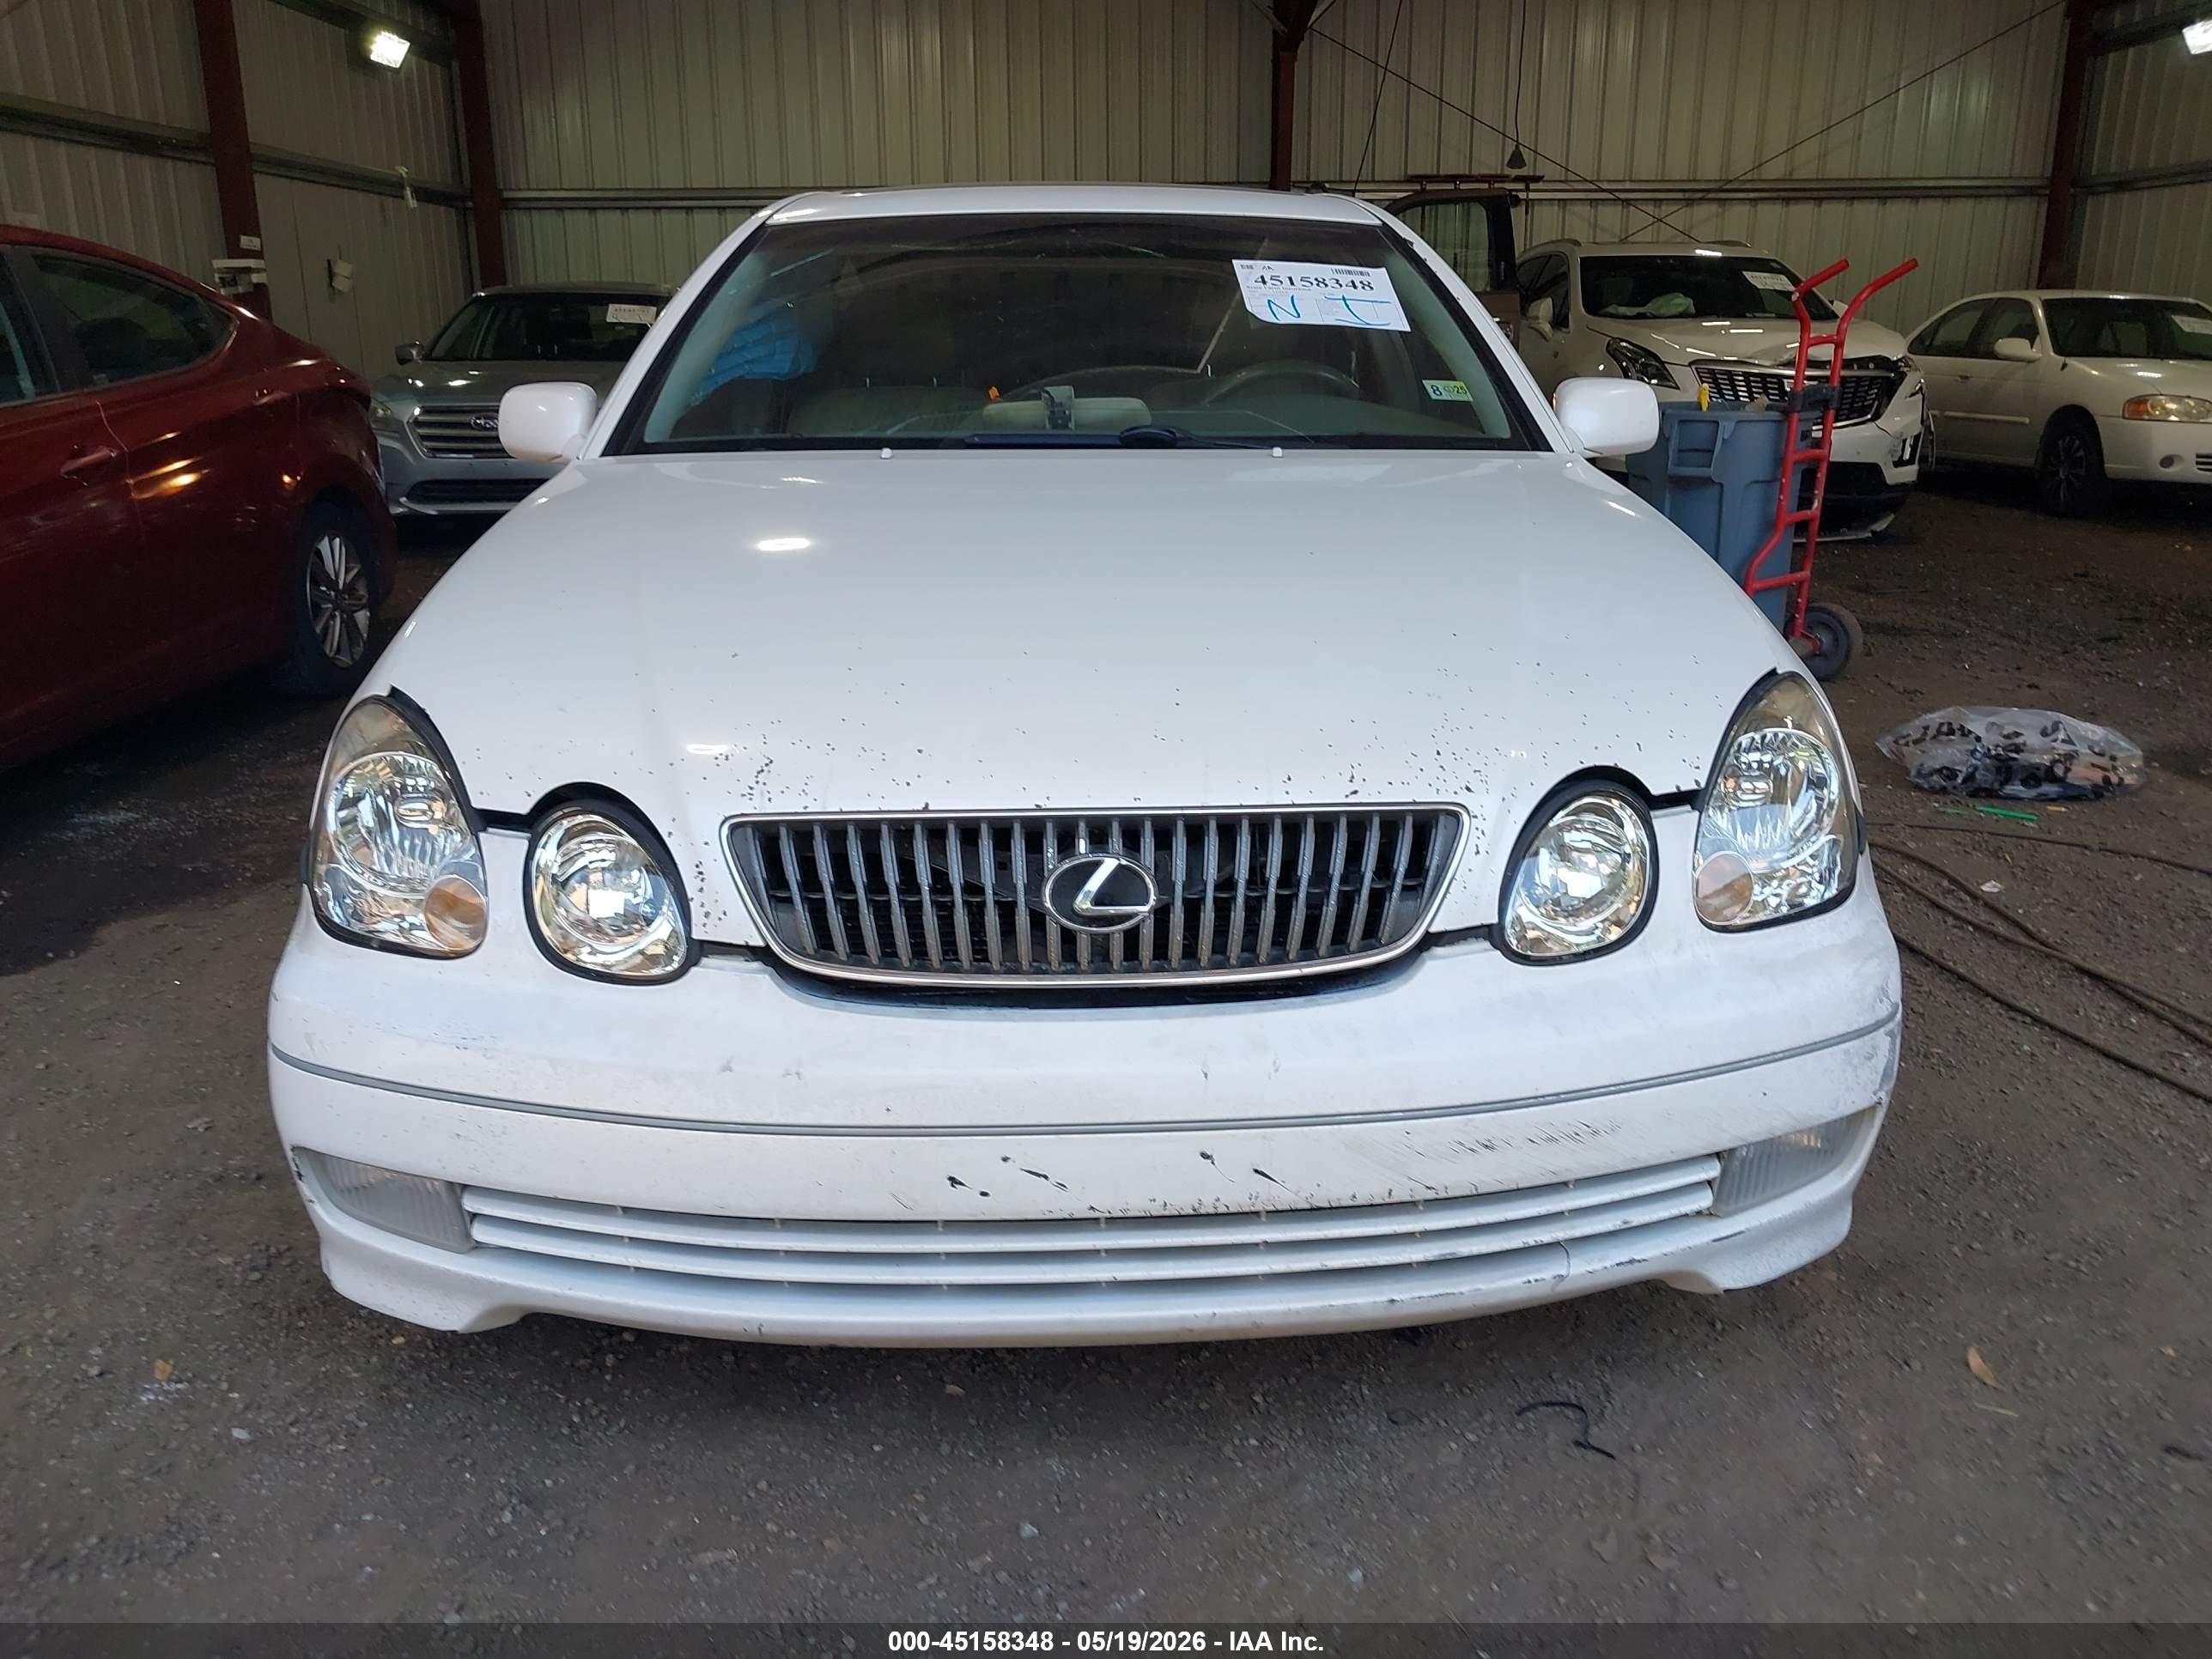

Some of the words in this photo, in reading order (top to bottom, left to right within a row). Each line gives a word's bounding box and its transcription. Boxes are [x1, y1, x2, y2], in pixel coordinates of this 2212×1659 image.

[1255, 274, 1374, 292] 45158348
[1267, 295, 1301, 321] N
[1431, 385, 1443, 396] 8
